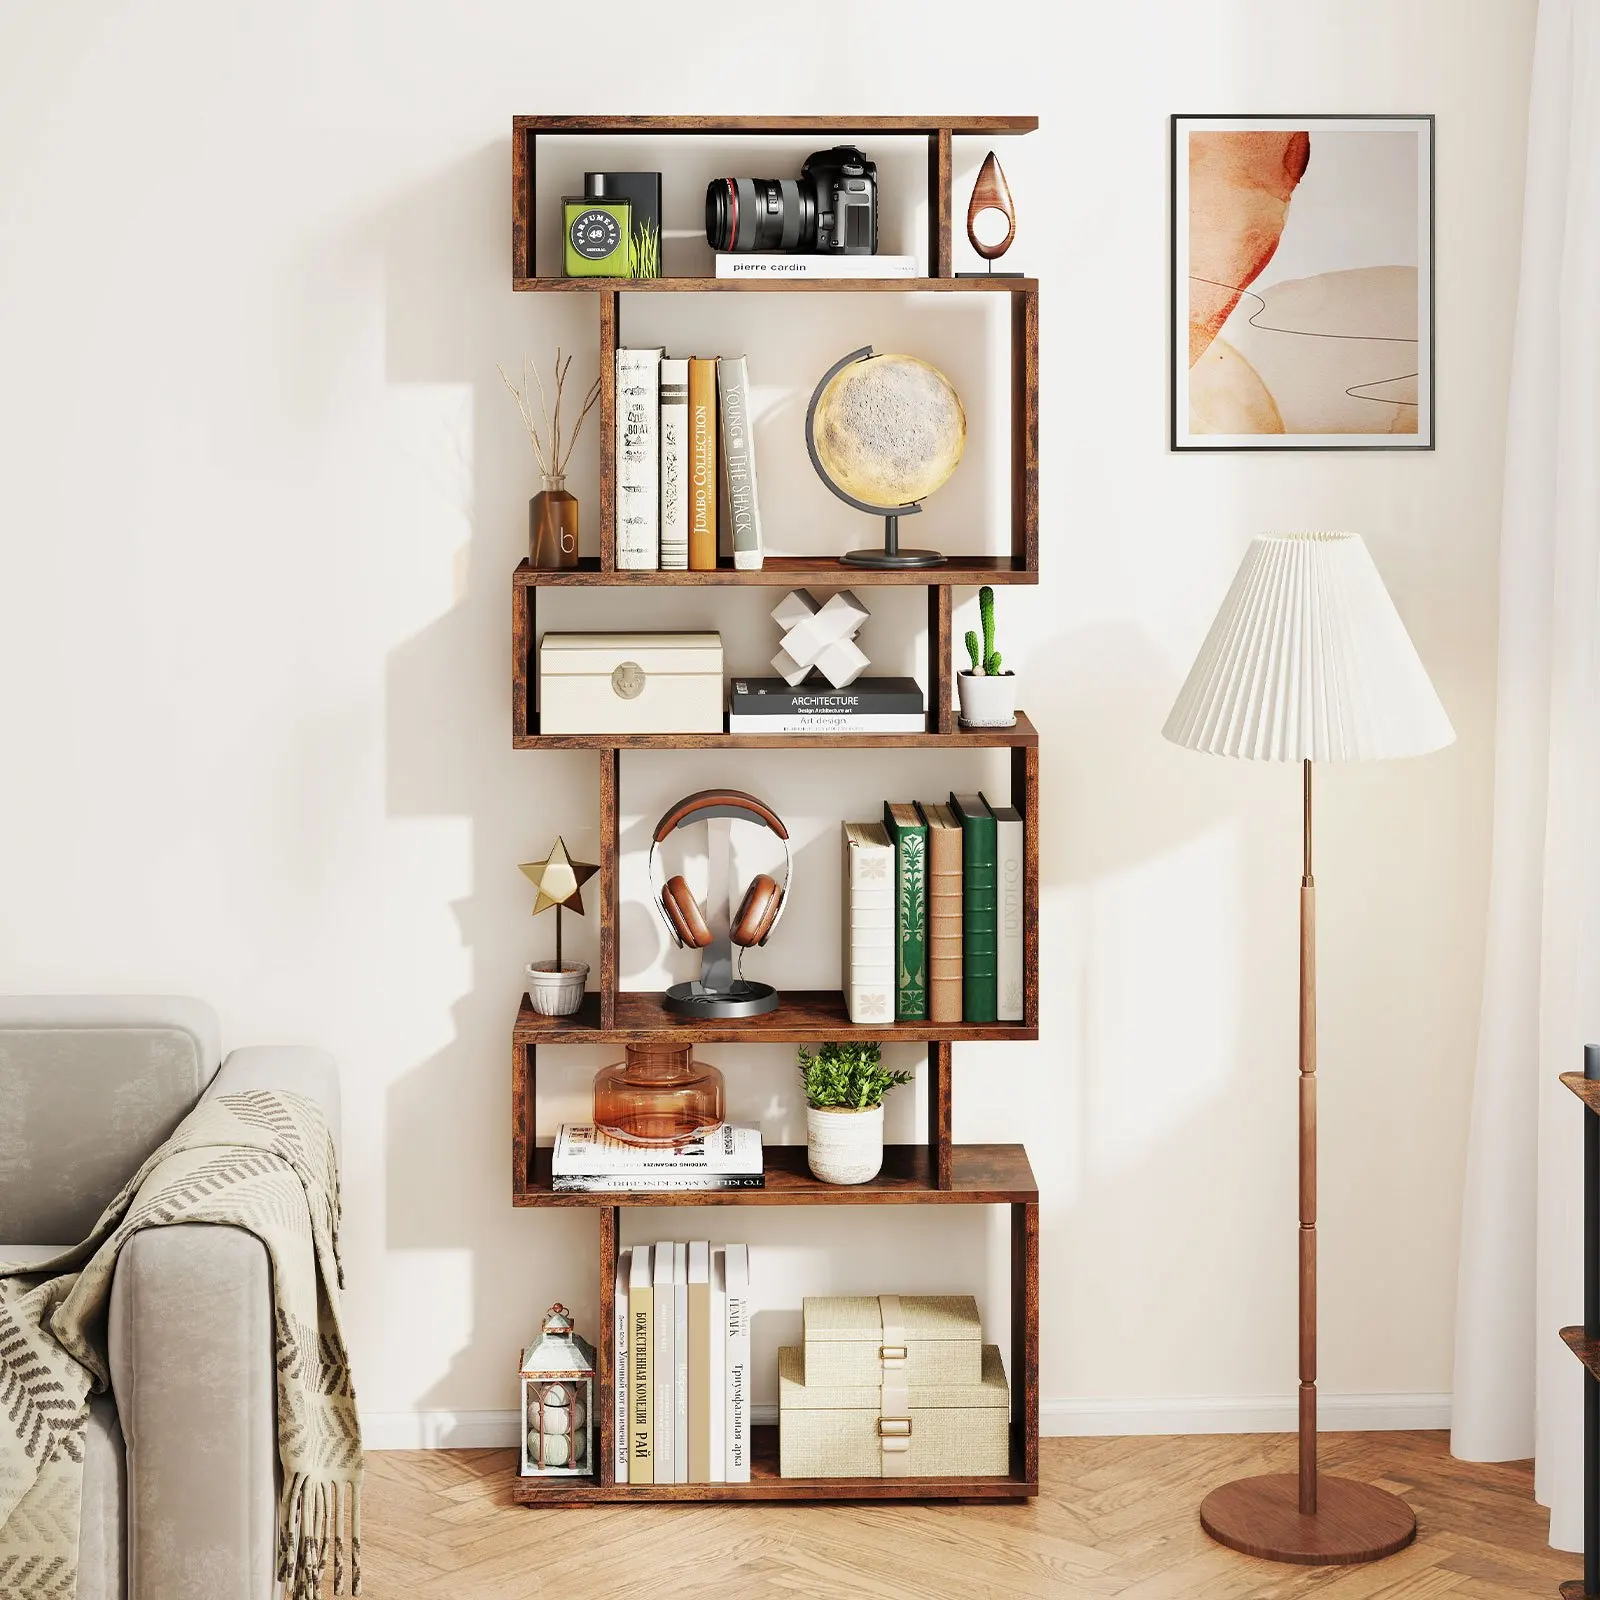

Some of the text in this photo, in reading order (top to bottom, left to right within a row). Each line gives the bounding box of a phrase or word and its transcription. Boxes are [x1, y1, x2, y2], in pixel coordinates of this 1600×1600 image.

[577, 214, 616, 245] PARFUMERIE
[590, 230, 603, 239] 48
[733, 262, 807, 272] pierre cardin
[693, 405, 710, 534] JUMBO COLLECTION
[726, 384, 751, 535] YOUNG THE SHACK
[560, 526, 575, 553] b
[791, 696, 859, 706] ARCHITECTURE
[816, 717, 847, 726] design
[619, 1351, 628, 1388] Уличный
[635, 1312, 651, 1458] БОЖЕСТВЕННАЯ КОМЕДИЯ РАЙ
[618, 1405, 625, 1417] по
[731, 1364, 744, 1466] Триумфальная арка
[619, 1447, 628, 1463] Боб
